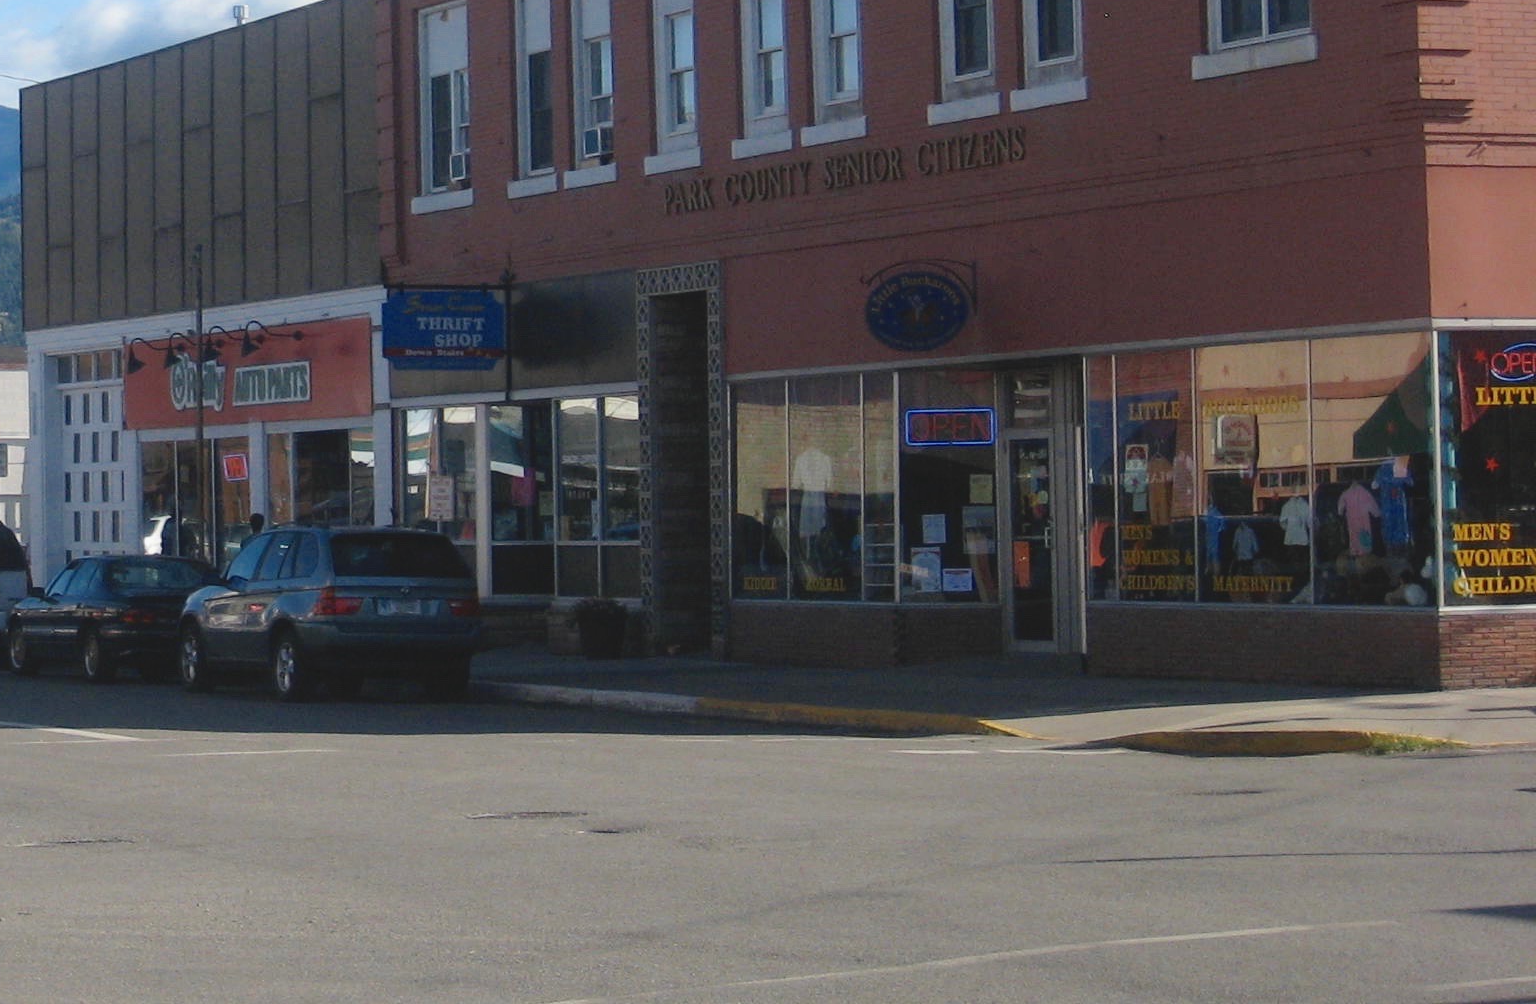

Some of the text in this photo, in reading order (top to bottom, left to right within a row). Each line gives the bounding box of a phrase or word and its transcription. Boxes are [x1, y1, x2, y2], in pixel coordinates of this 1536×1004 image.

[664, 125, 1026, 215] PARK COUNTY SENIOR CITIZENS
[416, 316, 485, 331] THRIFT
[434, 333, 483, 349] SHOP
[1491, 352, 1536, 374] OPE
[1128, 401, 1181, 421] LITTLE
[910, 412, 990, 442] OPEN
[1453, 522, 1511, 542] MEN'S
[1212, 575, 1294, 593] MATERNITY
